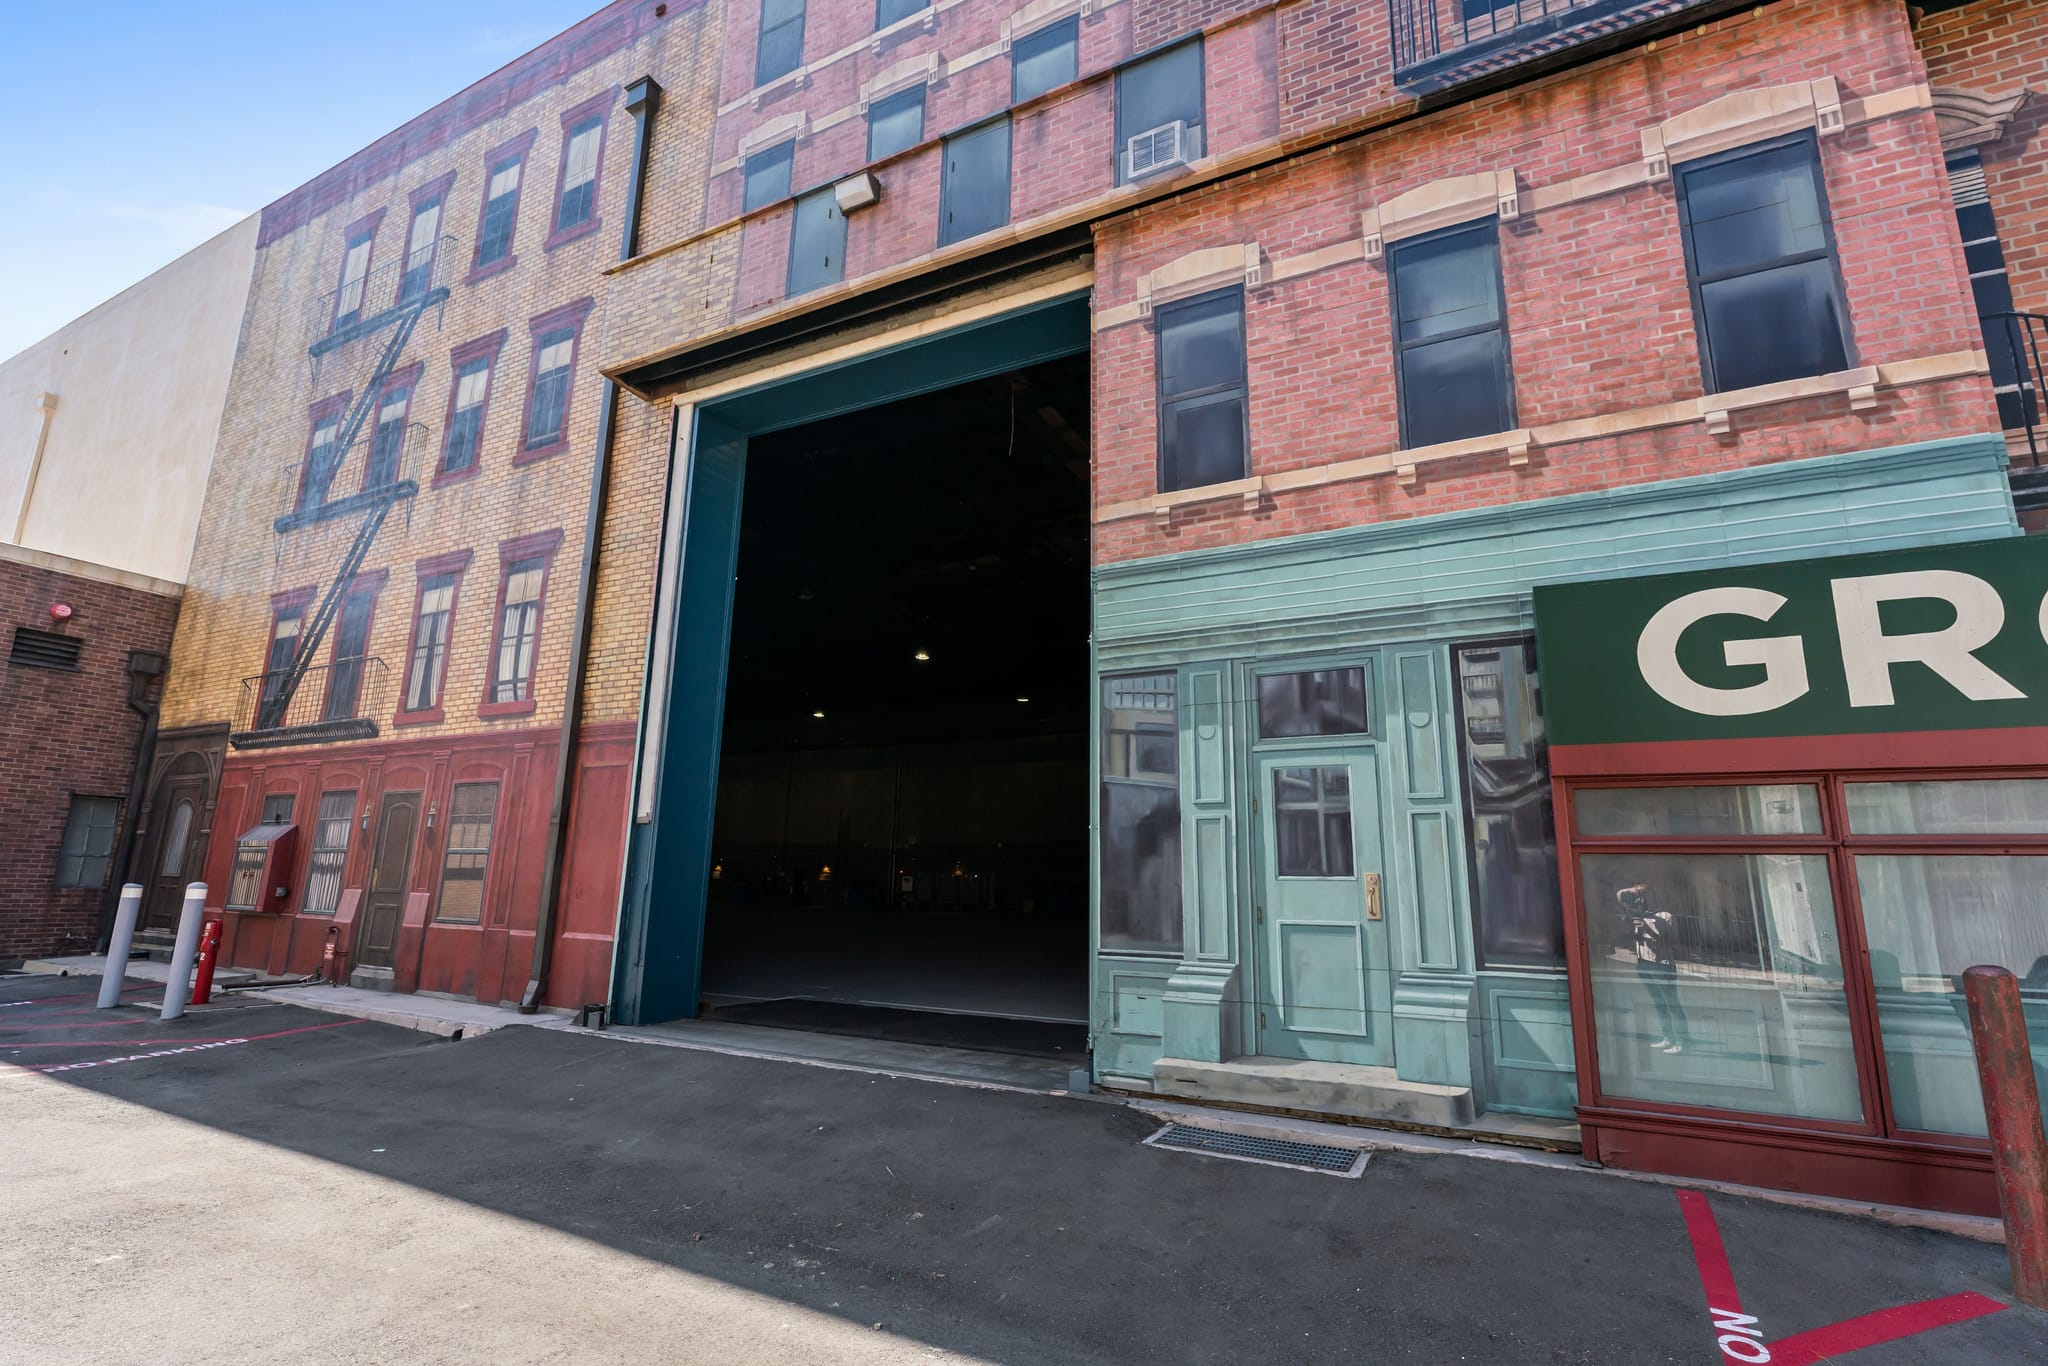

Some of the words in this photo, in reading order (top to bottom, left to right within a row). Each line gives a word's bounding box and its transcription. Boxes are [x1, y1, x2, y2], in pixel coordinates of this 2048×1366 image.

[1636, 569, 2048, 716] GR
[43, 1062, 97, 1073] NO
[105, 1038, 249, 1063] PARKING
[1709, 1307, 1771, 1364] NO
